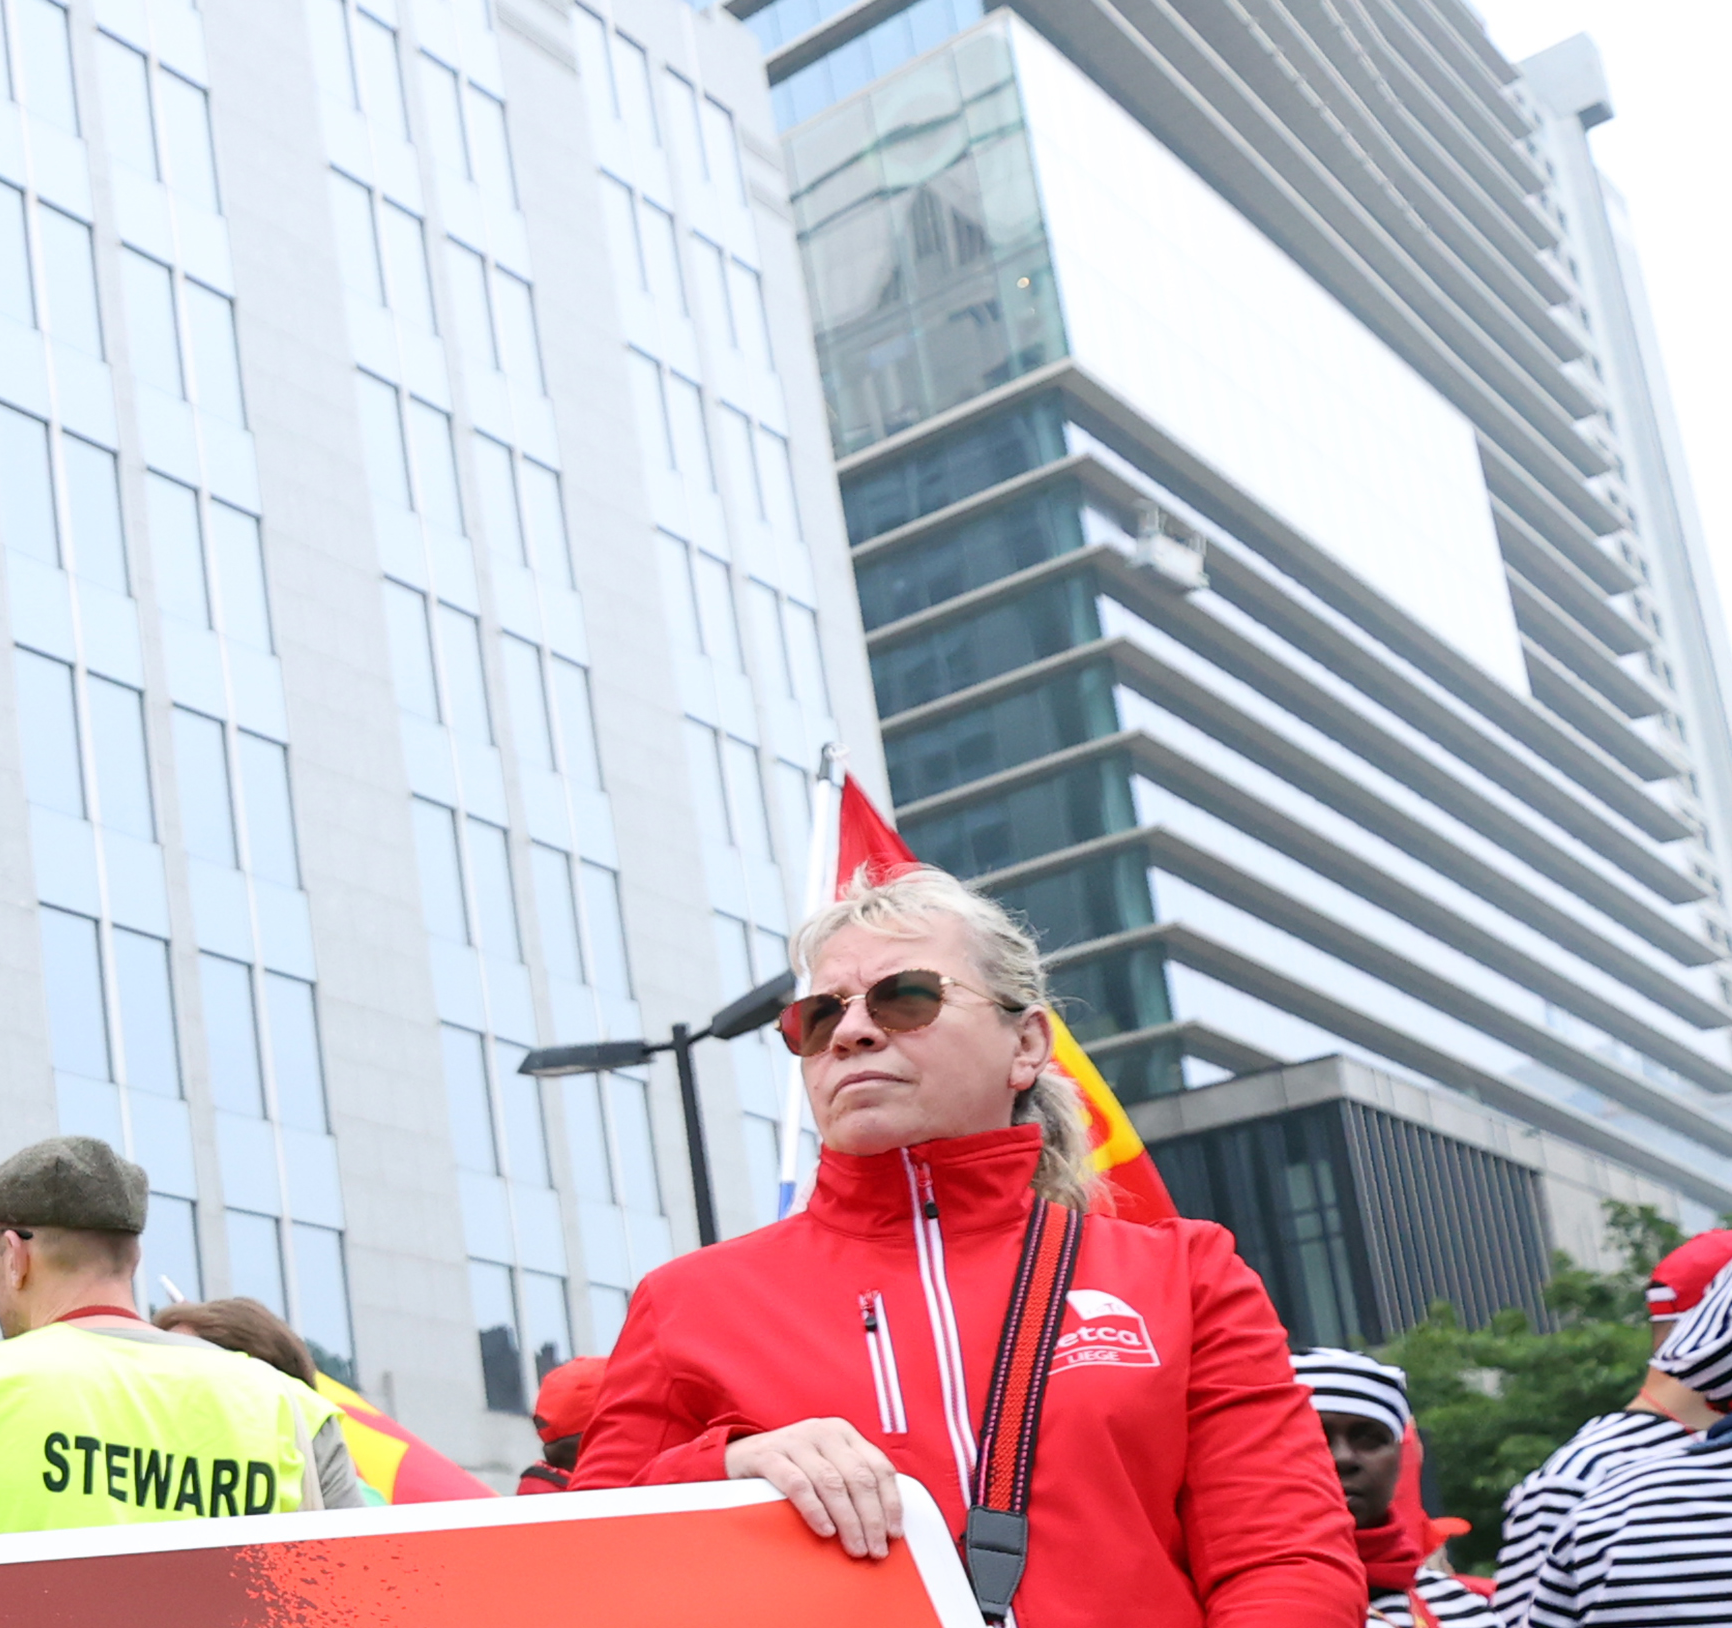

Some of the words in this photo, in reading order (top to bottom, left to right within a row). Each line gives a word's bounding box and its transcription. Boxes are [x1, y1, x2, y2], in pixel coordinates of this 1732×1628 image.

[1053, 1326, 1143, 1349] etca
[1066, 1349, 1121, 1365] LIEGE
[42, 1431, 277, 1519] STEWARD
